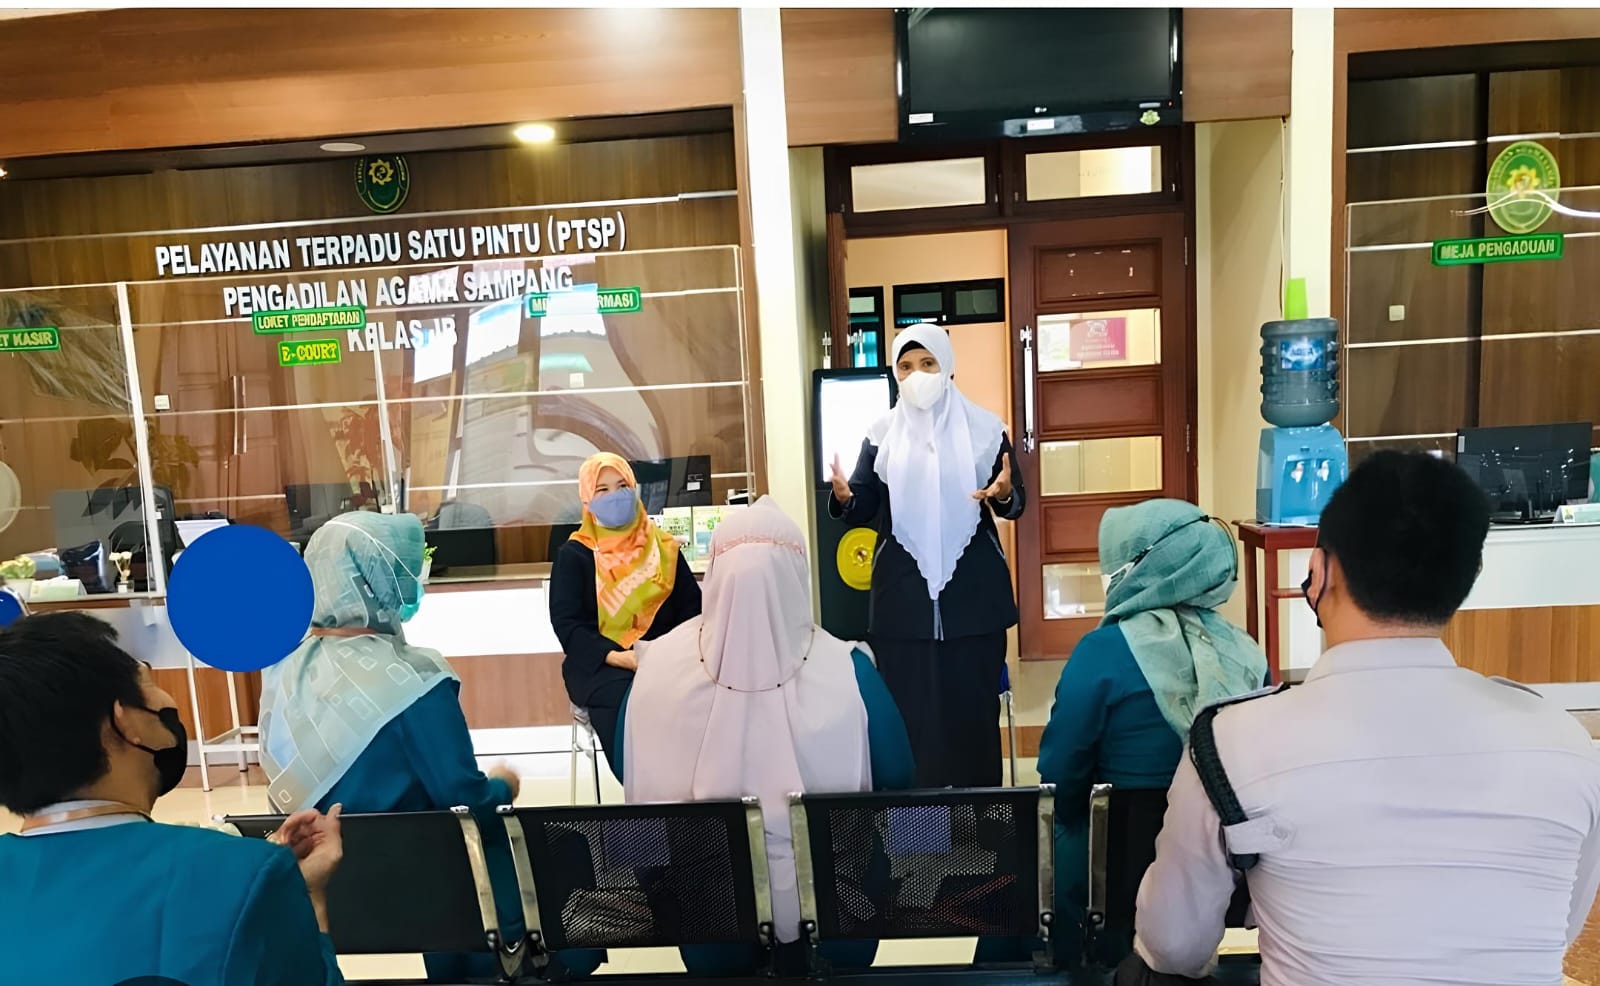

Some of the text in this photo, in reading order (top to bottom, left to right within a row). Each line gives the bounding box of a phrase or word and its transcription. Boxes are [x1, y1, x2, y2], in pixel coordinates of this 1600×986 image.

[155, 211, 626, 276] PELAYANAN TERPADU SATU PINTU (PTSP)
[1440, 243, 1475, 260] MEJA
[222, 265, 573, 316] PENGADILAN AGAMA SAMPANG
[258, 311, 361, 330] LOKET PENDAFTARAN
[13, 331, 53, 346] KASIR
